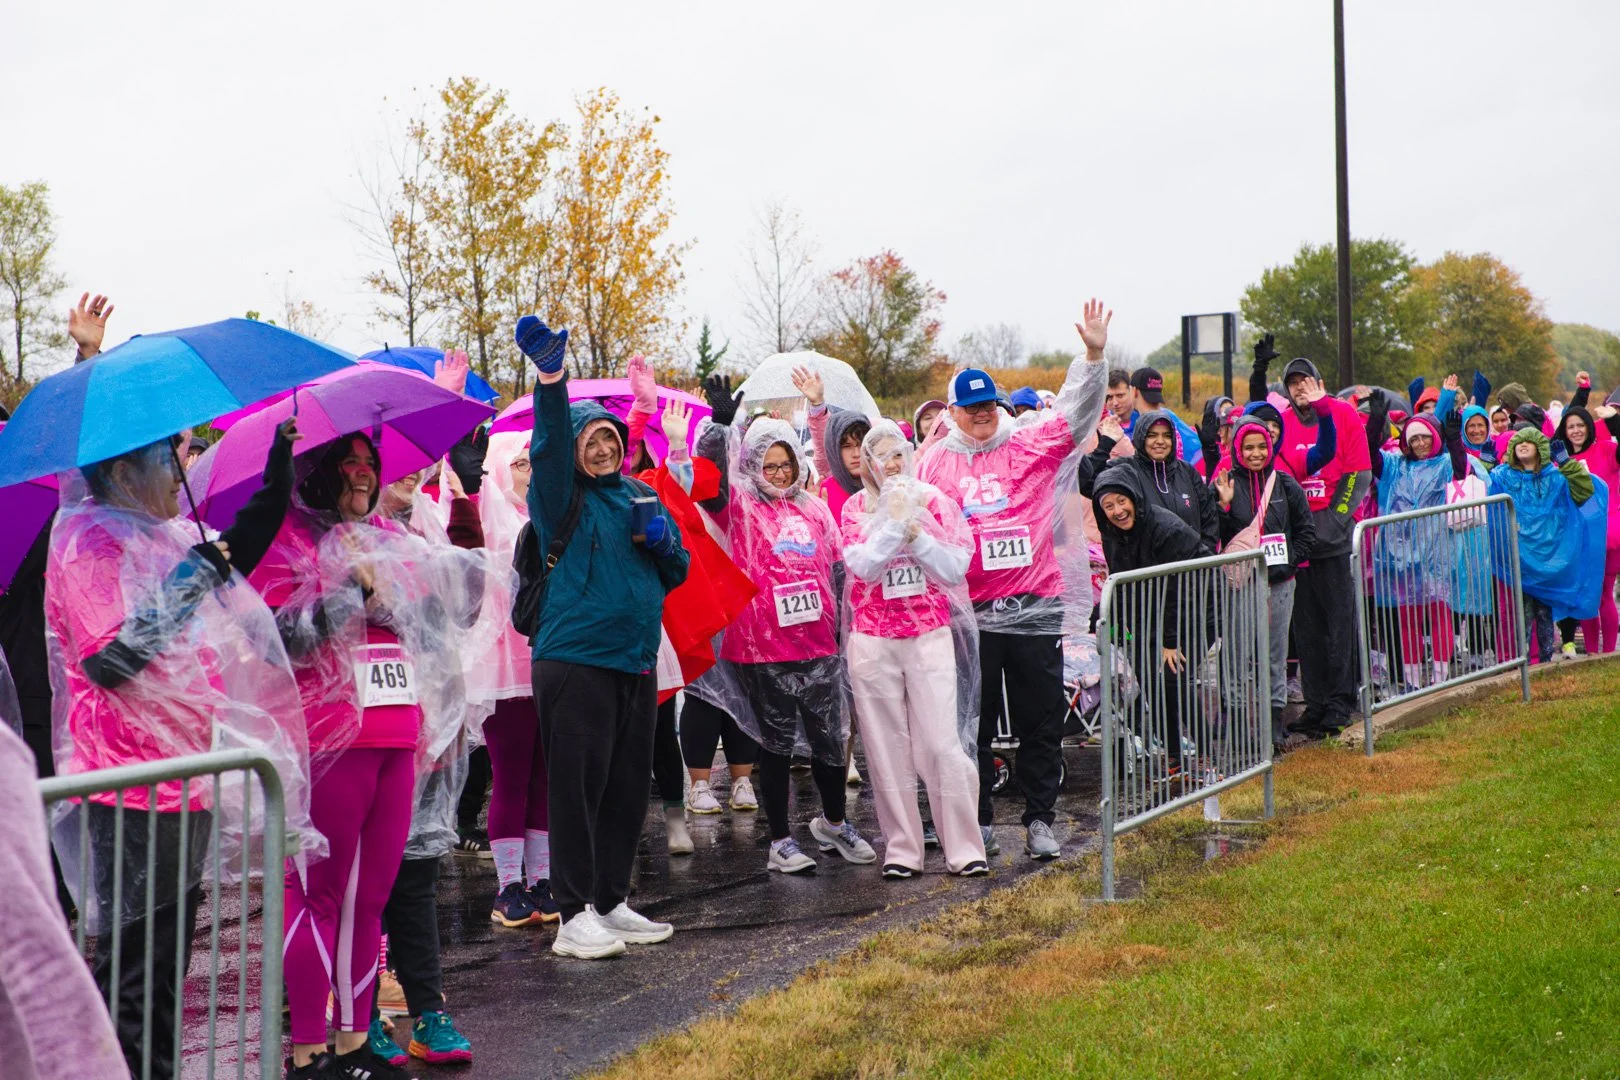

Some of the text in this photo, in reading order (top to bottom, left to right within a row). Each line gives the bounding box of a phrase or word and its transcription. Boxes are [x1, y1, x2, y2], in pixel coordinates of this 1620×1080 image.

[959, 473, 1002, 506] 25
[987, 539, 1027, 560] 1211
[1264, 543, 1285, 557] 415
[886, 565, 922, 588] 1212
[781, 592, 819, 616] 1210
[370, 663, 407, 689] 469
